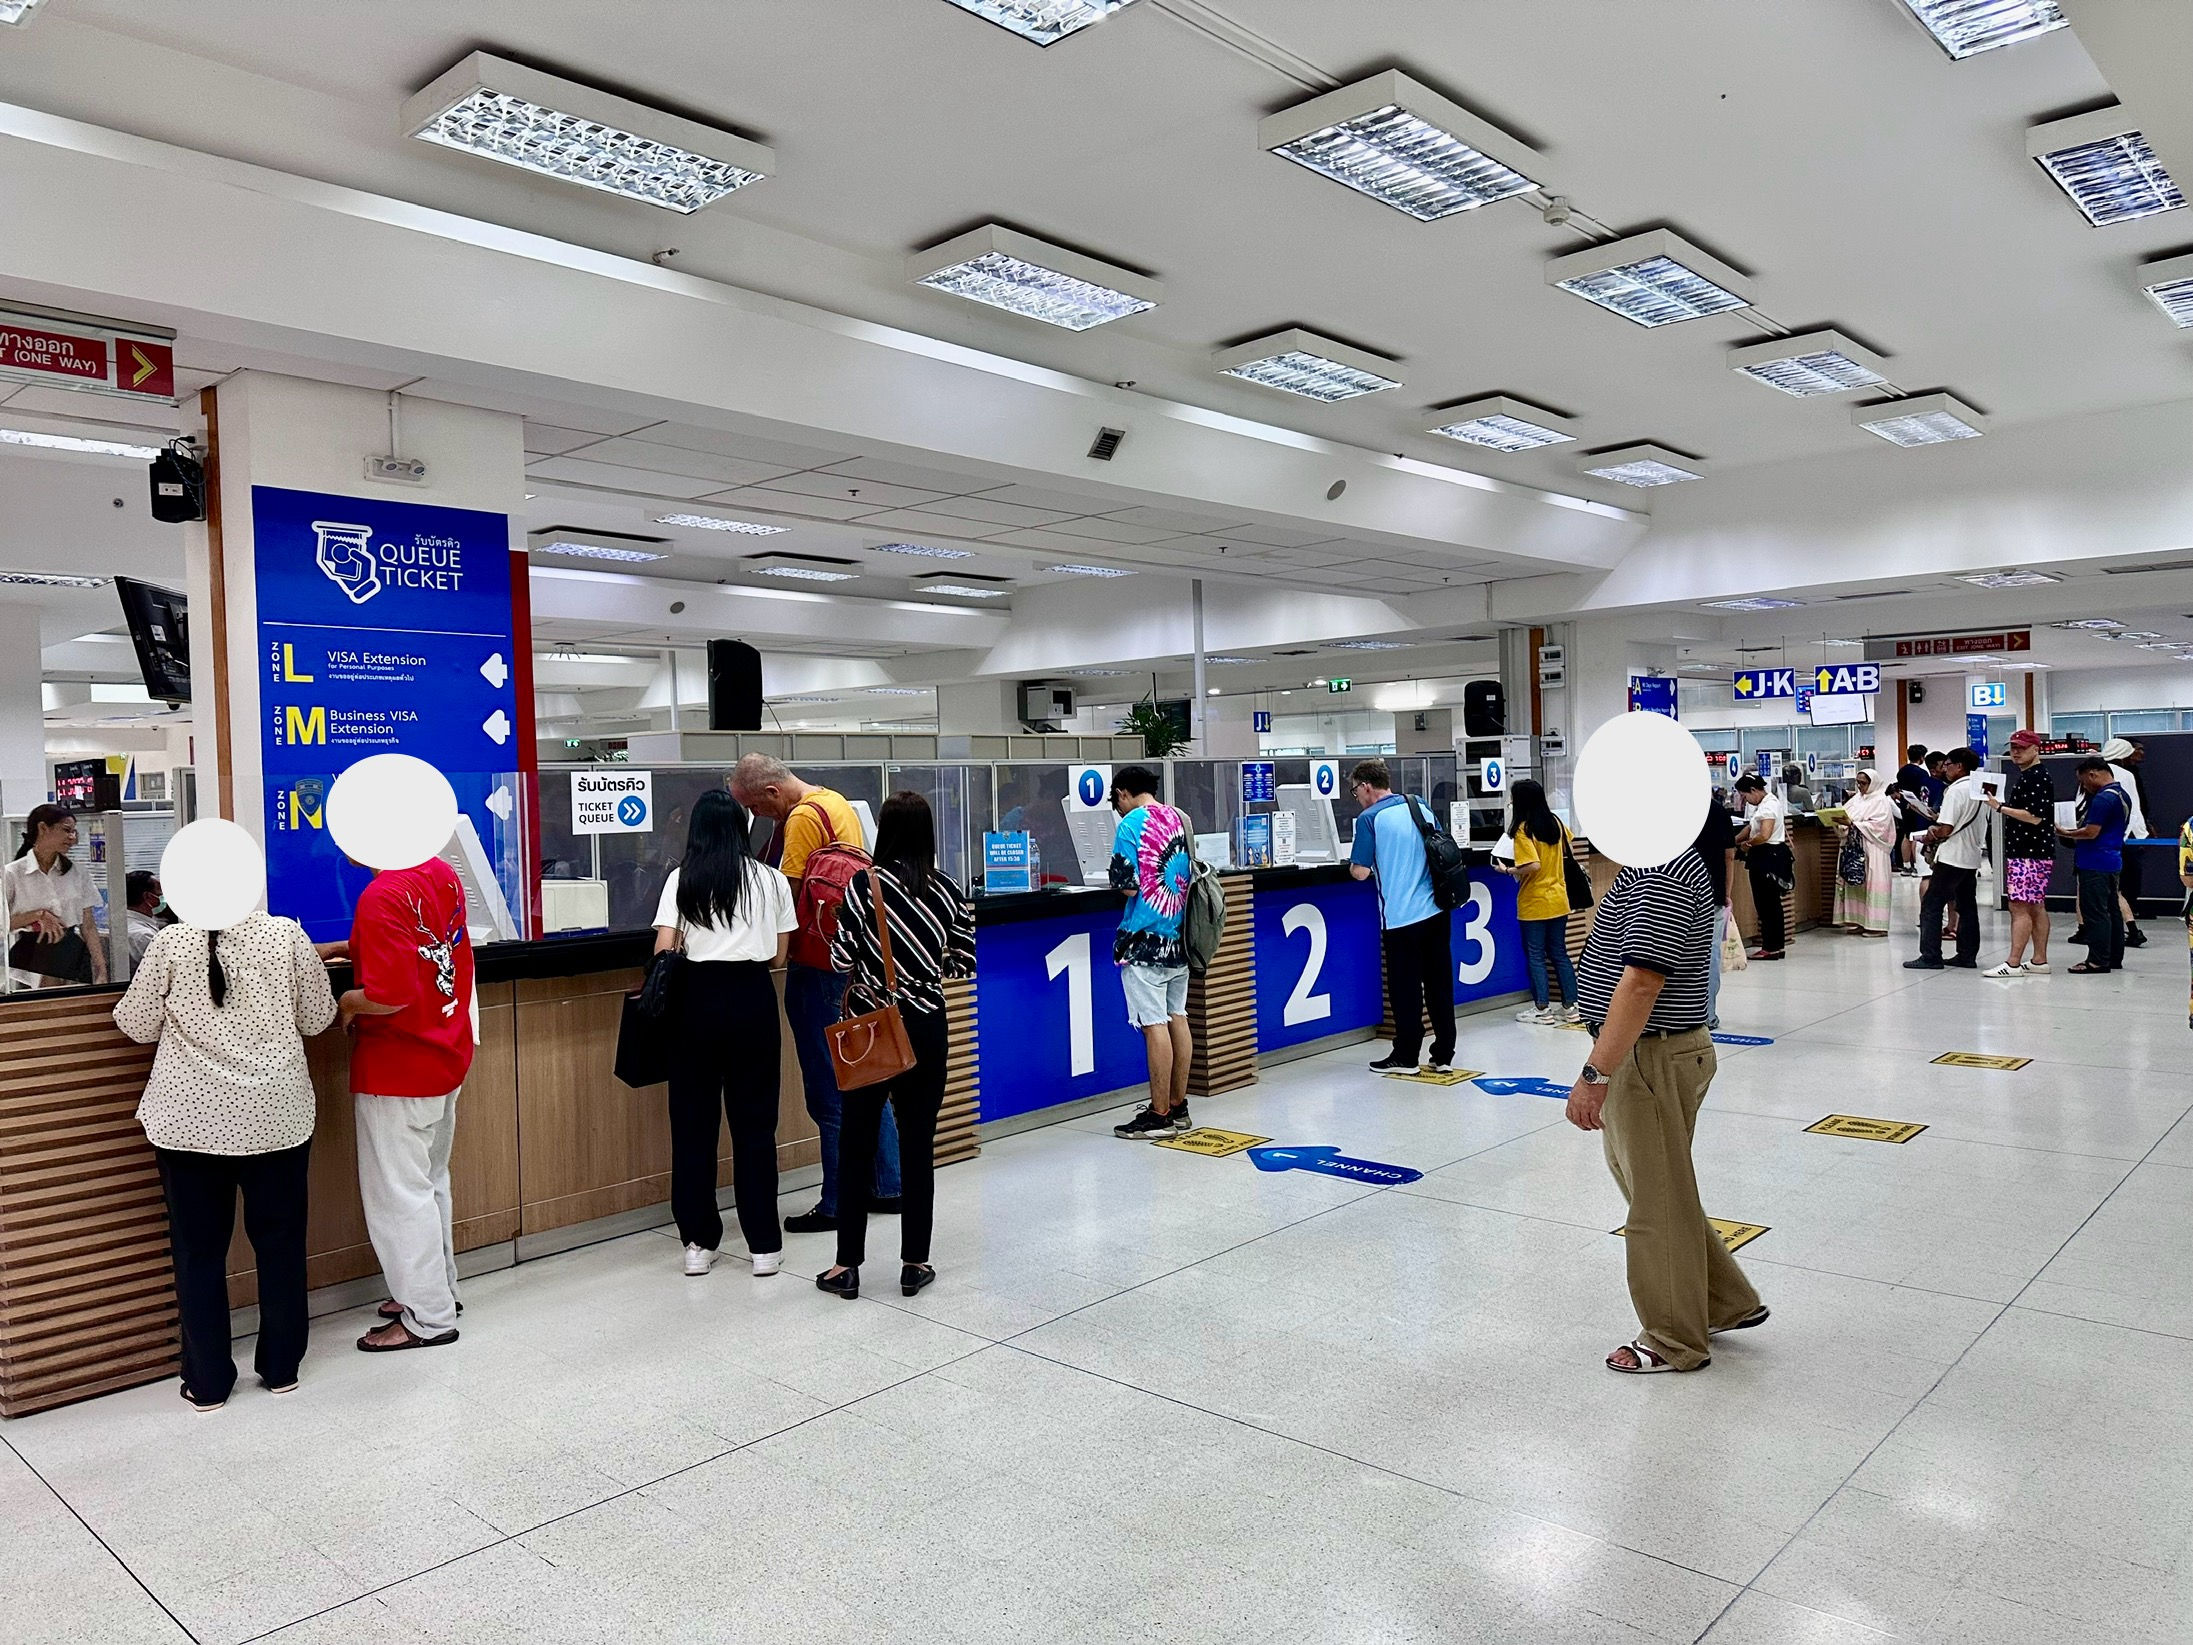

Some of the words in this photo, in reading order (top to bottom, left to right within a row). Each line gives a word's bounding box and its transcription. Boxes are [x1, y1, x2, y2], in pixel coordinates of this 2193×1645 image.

[14, 350, 52, 365] (ONE
[59, 356, 96, 374] WAY)
[414, 534, 461, 549] รับบัตรคิว
[380, 543, 462, 568] QUEUE
[380, 566, 463, 591] TICKET
[272, 642, 281, 682] ZONE
[284, 643, 314, 682] L
[327, 651, 358, 663] VISA
[363, 653, 427, 666] Extension
[1635, 678, 1642, 695] A
[1974, 686, 1992, 706] B
[330, 709, 385, 721] Business
[389, 711, 418, 721] VISA
[1256, 714, 1262, 731] J
[274, 706, 283, 746] ZONE
[286, 706, 326, 745] M
[330, 723, 393, 734] Extension
[577, 776, 645, 791] รับบัตรคิว
[1320, 770, 1330, 788] 2
[1490, 768, 1498, 783] 3
[1086, 777, 1095, 798] 1
[277, 791, 286, 830] ZONE
[289, 791, 323, 830] N
[578, 802, 613, 811] TICKET
[578, 813, 614, 824] QUEUE
[1458, 881, 1496, 985] 3
[1281, 903, 1331, 1027] 2
[1045, 933, 1095, 1078] 1
[1272, 1151, 1299, 1159] 1
[1317, 1159, 1402, 1179] CHANNEL
